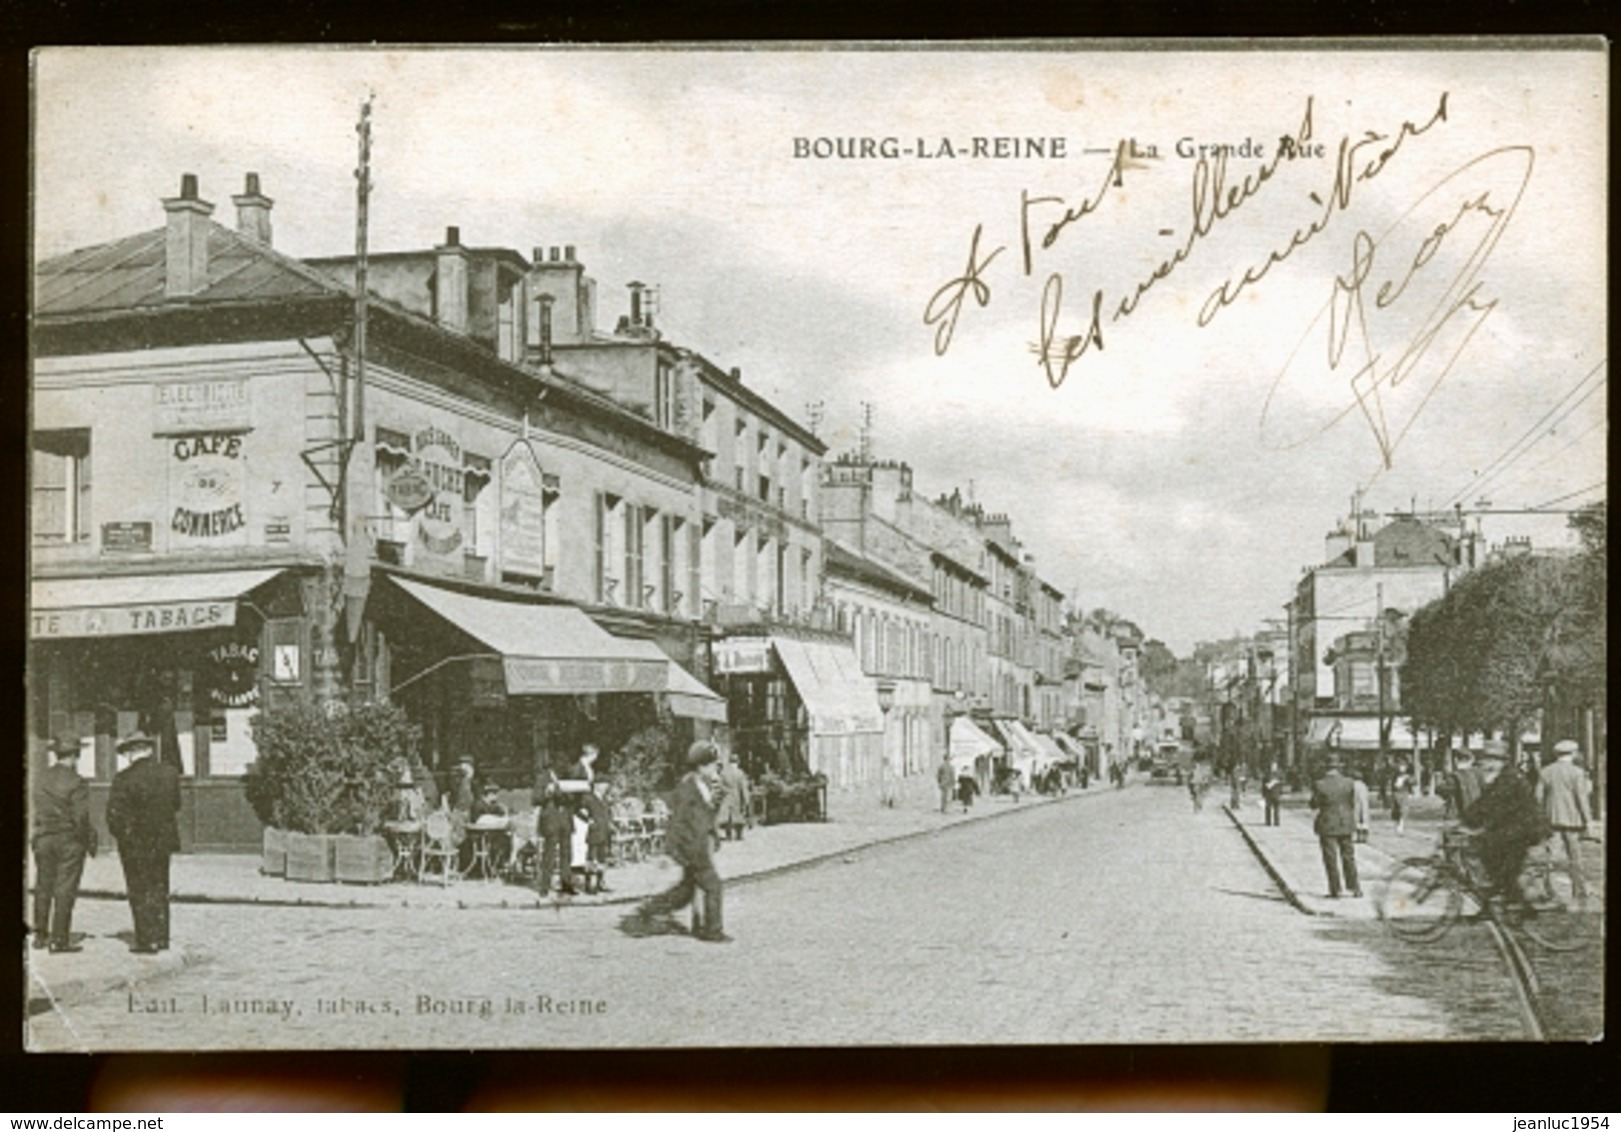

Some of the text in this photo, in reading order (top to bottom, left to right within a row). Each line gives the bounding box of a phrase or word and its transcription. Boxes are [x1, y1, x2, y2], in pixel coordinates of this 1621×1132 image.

[171, 502, 246, 537] COMMERCE
[130, 604, 222, 630] TABACS
[210, 642, 259, 663] TABAC
